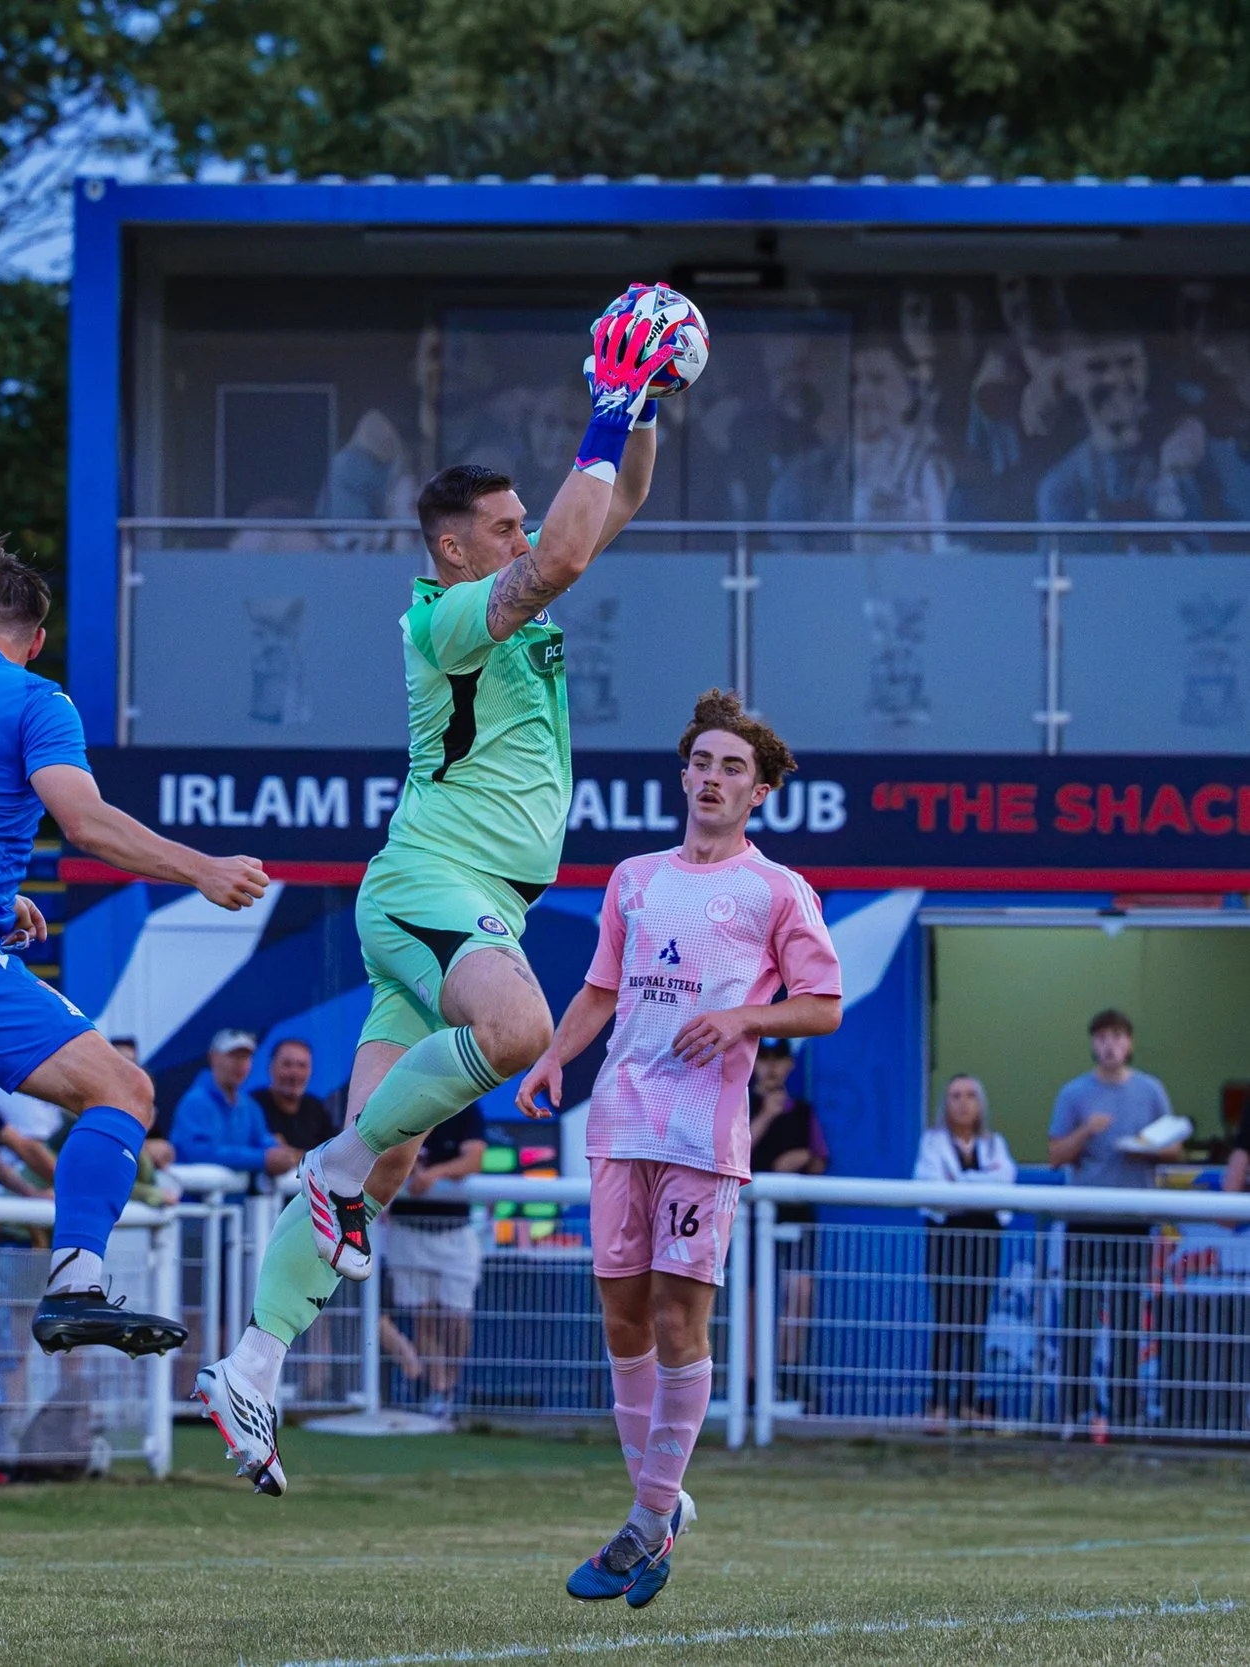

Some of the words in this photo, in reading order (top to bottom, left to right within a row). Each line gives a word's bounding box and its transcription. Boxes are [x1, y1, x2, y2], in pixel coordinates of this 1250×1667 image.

[158, 774, 350, 829] IRLAM
[746, 779, 848, 833] UB
[643, 988, 658, 1001] UK
[658, 990, 679, 1005] LTD.
[667, 977, 703, 994] STEELS
[668, 1202, 700, 1239] 16
